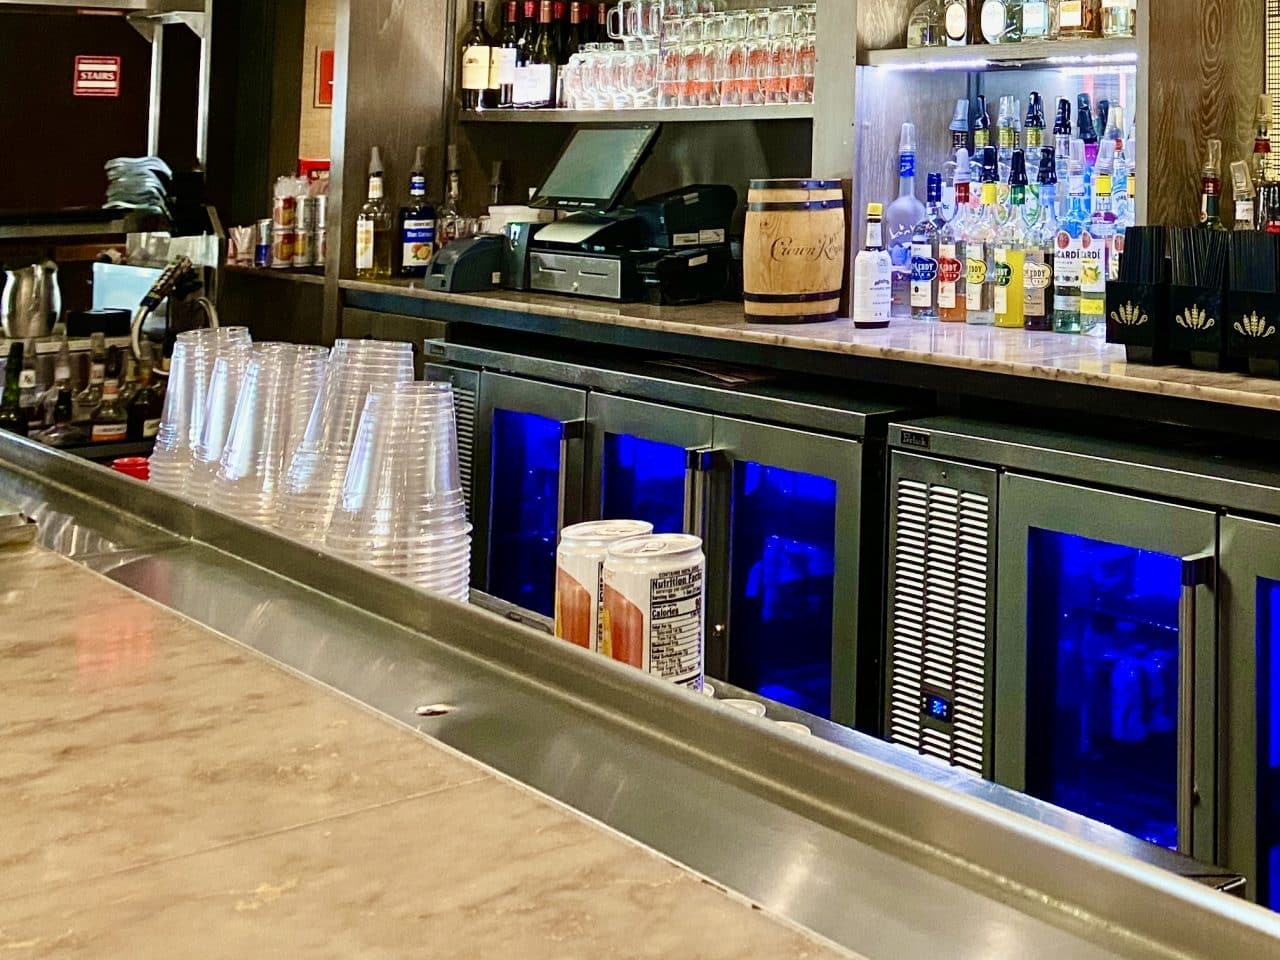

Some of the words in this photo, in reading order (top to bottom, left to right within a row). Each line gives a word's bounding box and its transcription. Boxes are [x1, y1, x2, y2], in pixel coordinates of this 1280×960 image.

[80, 71, 115, 80] STAIRS
[771, 237, 816, 262] Crown
[1055, 248, 1080, 259] CARDÍ
[652, 575, 687, 589] Nutrition
[652, 608, 678, 618] Calories
